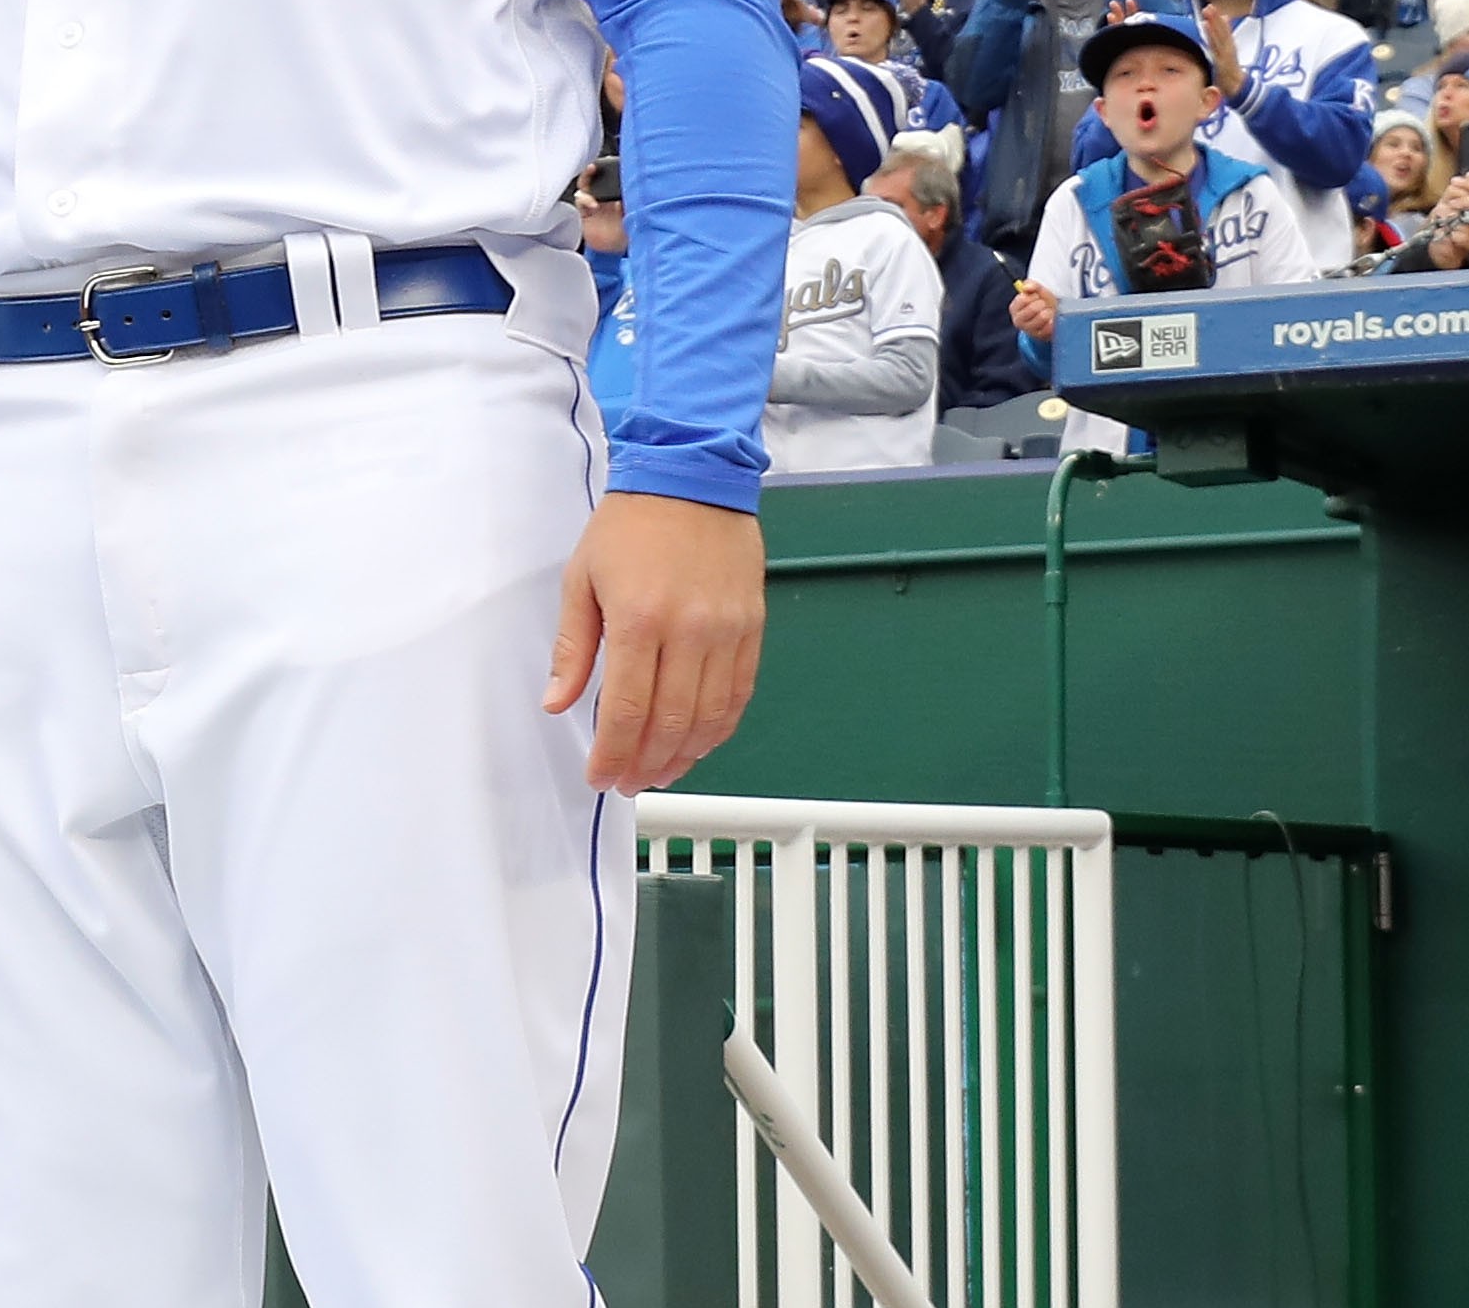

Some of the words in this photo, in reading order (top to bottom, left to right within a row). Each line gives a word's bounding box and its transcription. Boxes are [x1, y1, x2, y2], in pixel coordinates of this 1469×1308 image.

[1150, 325, 1187, 342] NEW
[1273, 310, 1469, 349] royals.com
[1150, 342, 1187, 358] ERA
